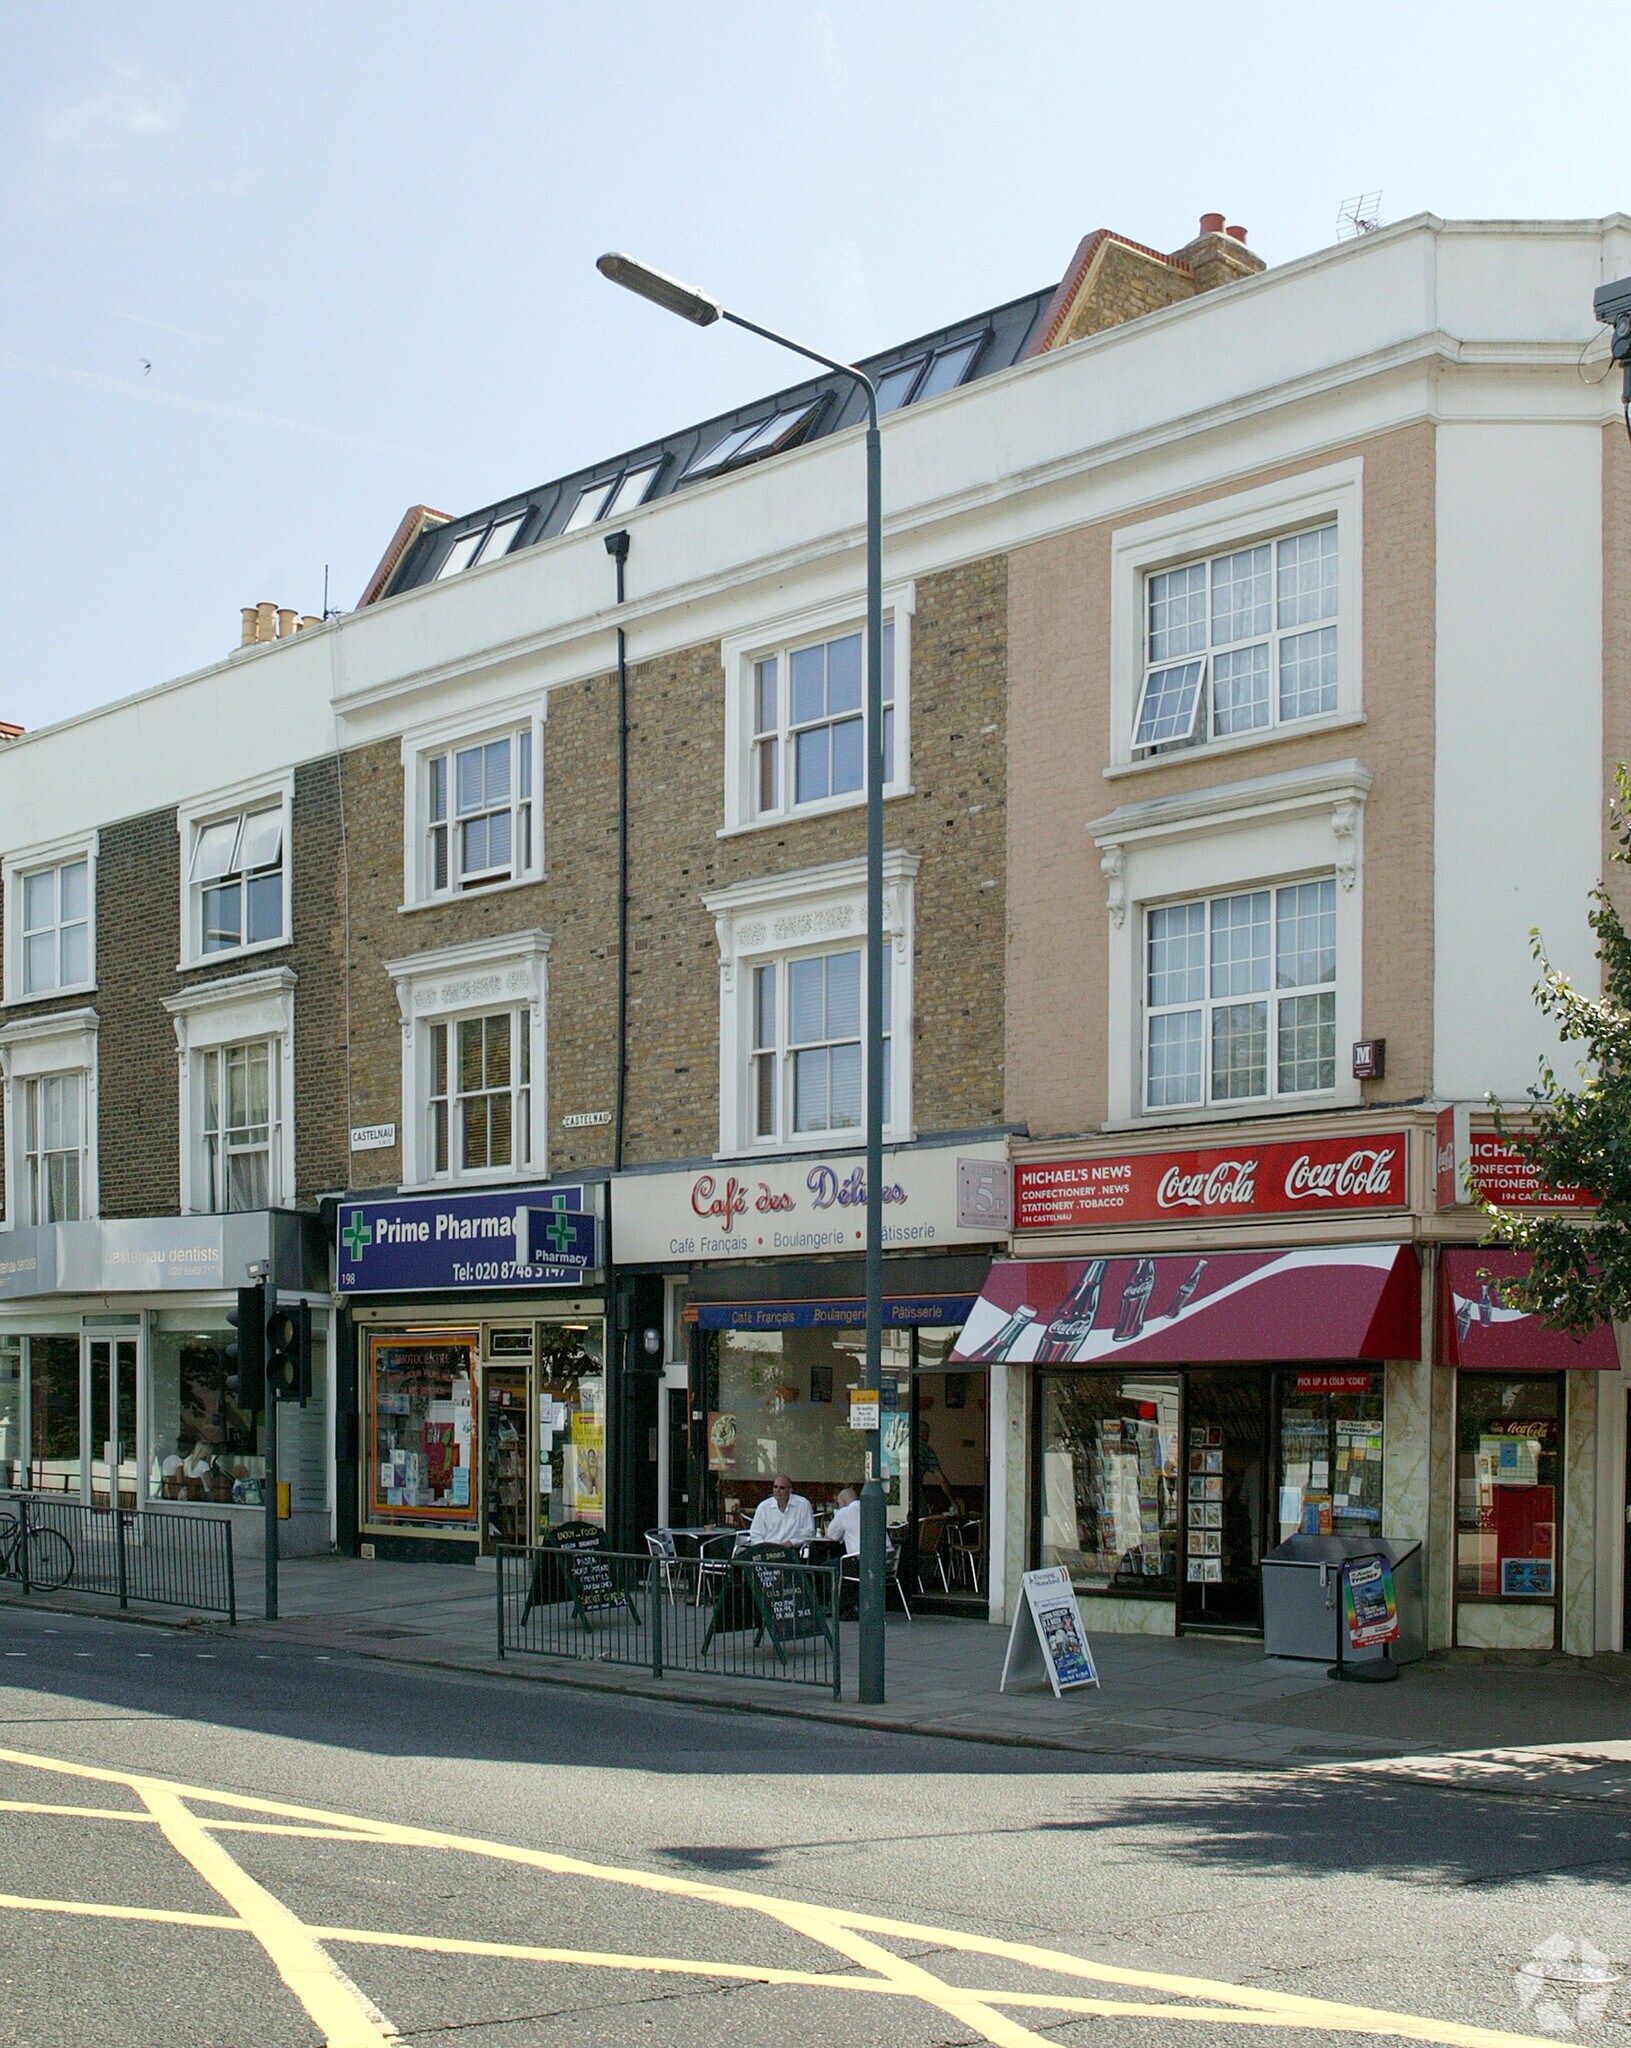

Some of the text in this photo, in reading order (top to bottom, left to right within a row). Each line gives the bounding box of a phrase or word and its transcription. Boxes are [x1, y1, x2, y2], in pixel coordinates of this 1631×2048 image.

[1355, 1046, 1370, 1065] M
[565, 1113, 609, 1126] CASTELNAU
[352, 1128, 393, 1142] CASTELNAU
[1022, 1165, 1132, 1185] MICHAEL'S NEWS
[1285, 1149, 1396, 1200] Coca-Cola
[1022, 1184, 1130, 1200] CONFECTIONERY NEWS
[1157, 1160, 1258, 1209] Coca-Cola
[1471, 1178, 1540, 1189] TATIONERY
[691, 1165, 908, 1234] Café des Délies
[1022, 1197, 1124, 1213] STATIONERY TOBACCO
[1502, 1192, 1576, 1201] 194 CATENAU
[1033, 1213, 1072, 1222] CASTELNAU
[376, 1214, 516, 1244] Prime Pharma
[669, 1222, 935, 1255] Café Français Boulangerie âtisserie
[169, 1245, 219, 1262] dentists
[535, 1249, 588, 1266] Pharmacy
[341, 1272, 356, 1285] 198
[452, 1262, 474, 1281] Tel:
[475, 1261, 499, 1280] 020
[731, 1304, 942, 1325] Café Français Boulangeri Pâtisserie
[1298, 1377, 1312, 1387] PICK
[1322, 1377, 1328, 1386] A
[1328, 1377, 1345, 1386] COLD
